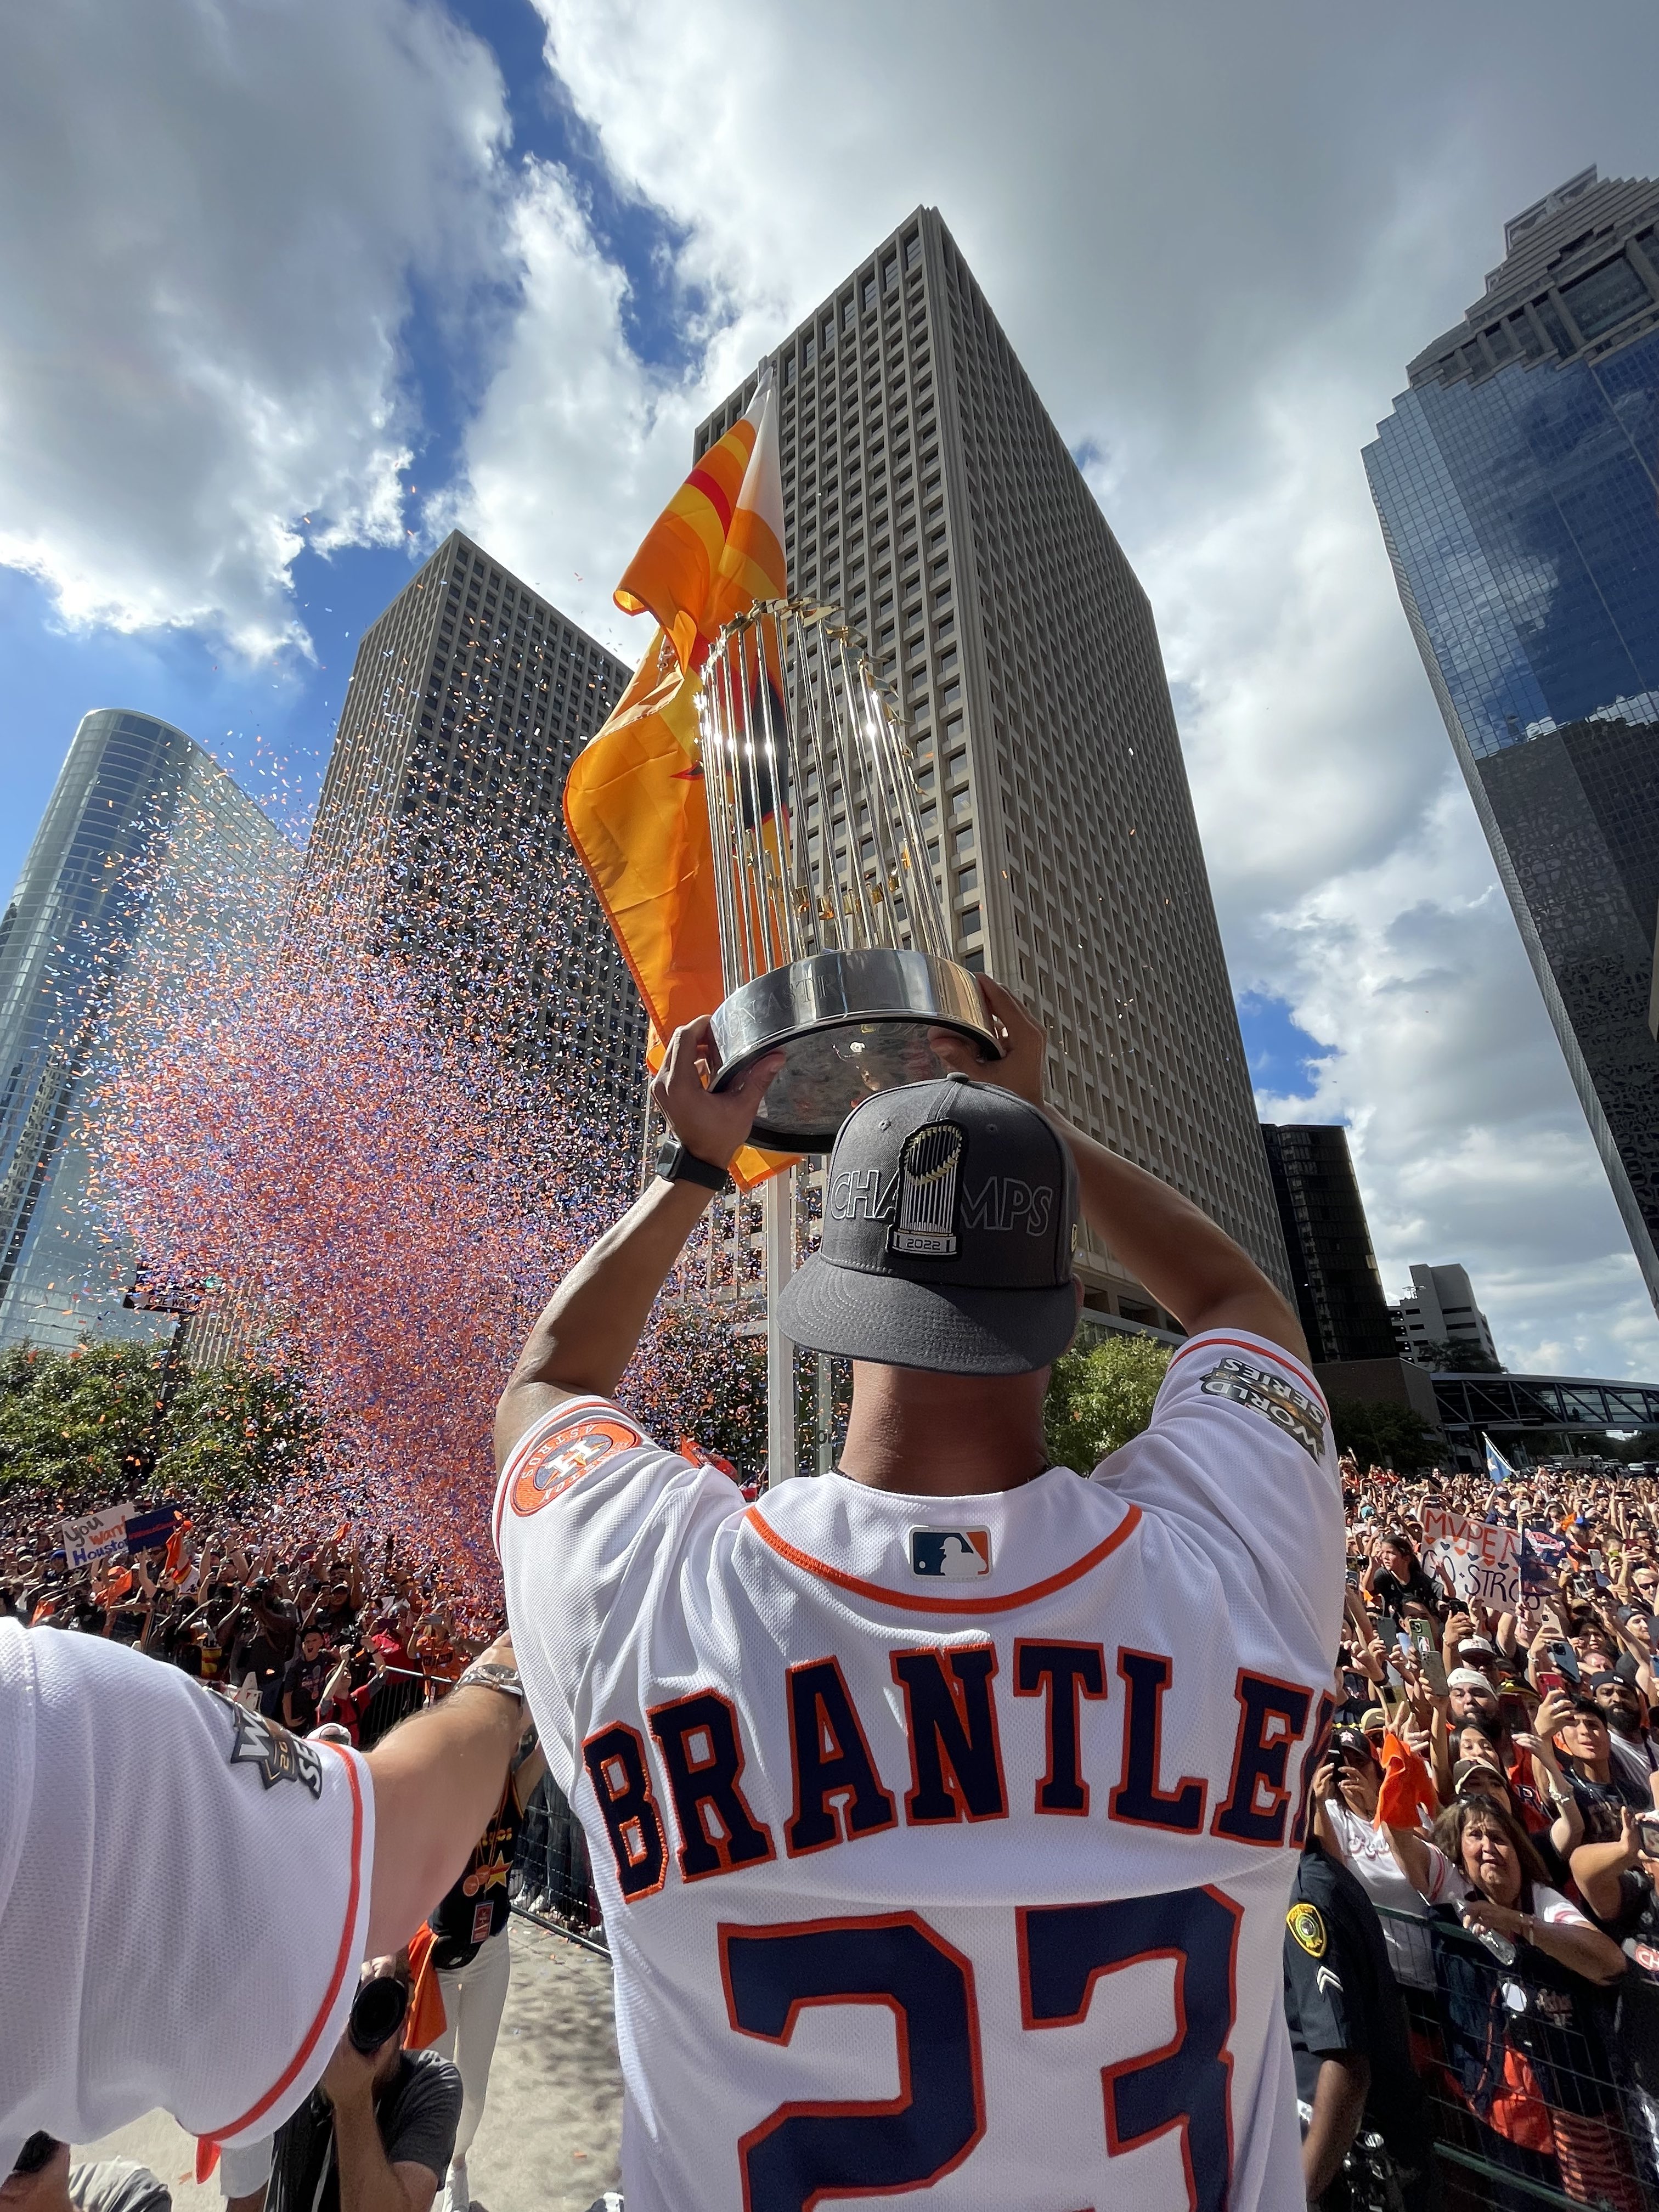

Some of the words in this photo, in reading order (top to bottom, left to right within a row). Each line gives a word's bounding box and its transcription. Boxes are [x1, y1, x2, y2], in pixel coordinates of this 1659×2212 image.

[831, 1169, 1053, 1237] CHAMPS
[907, 1238, 941, 1251] 2022
[1224, 1358, 1325, 1424] SERIES
[522, 1424, 599, 1480] ASTROS
[717, 1883, 1244, 2212] 23
